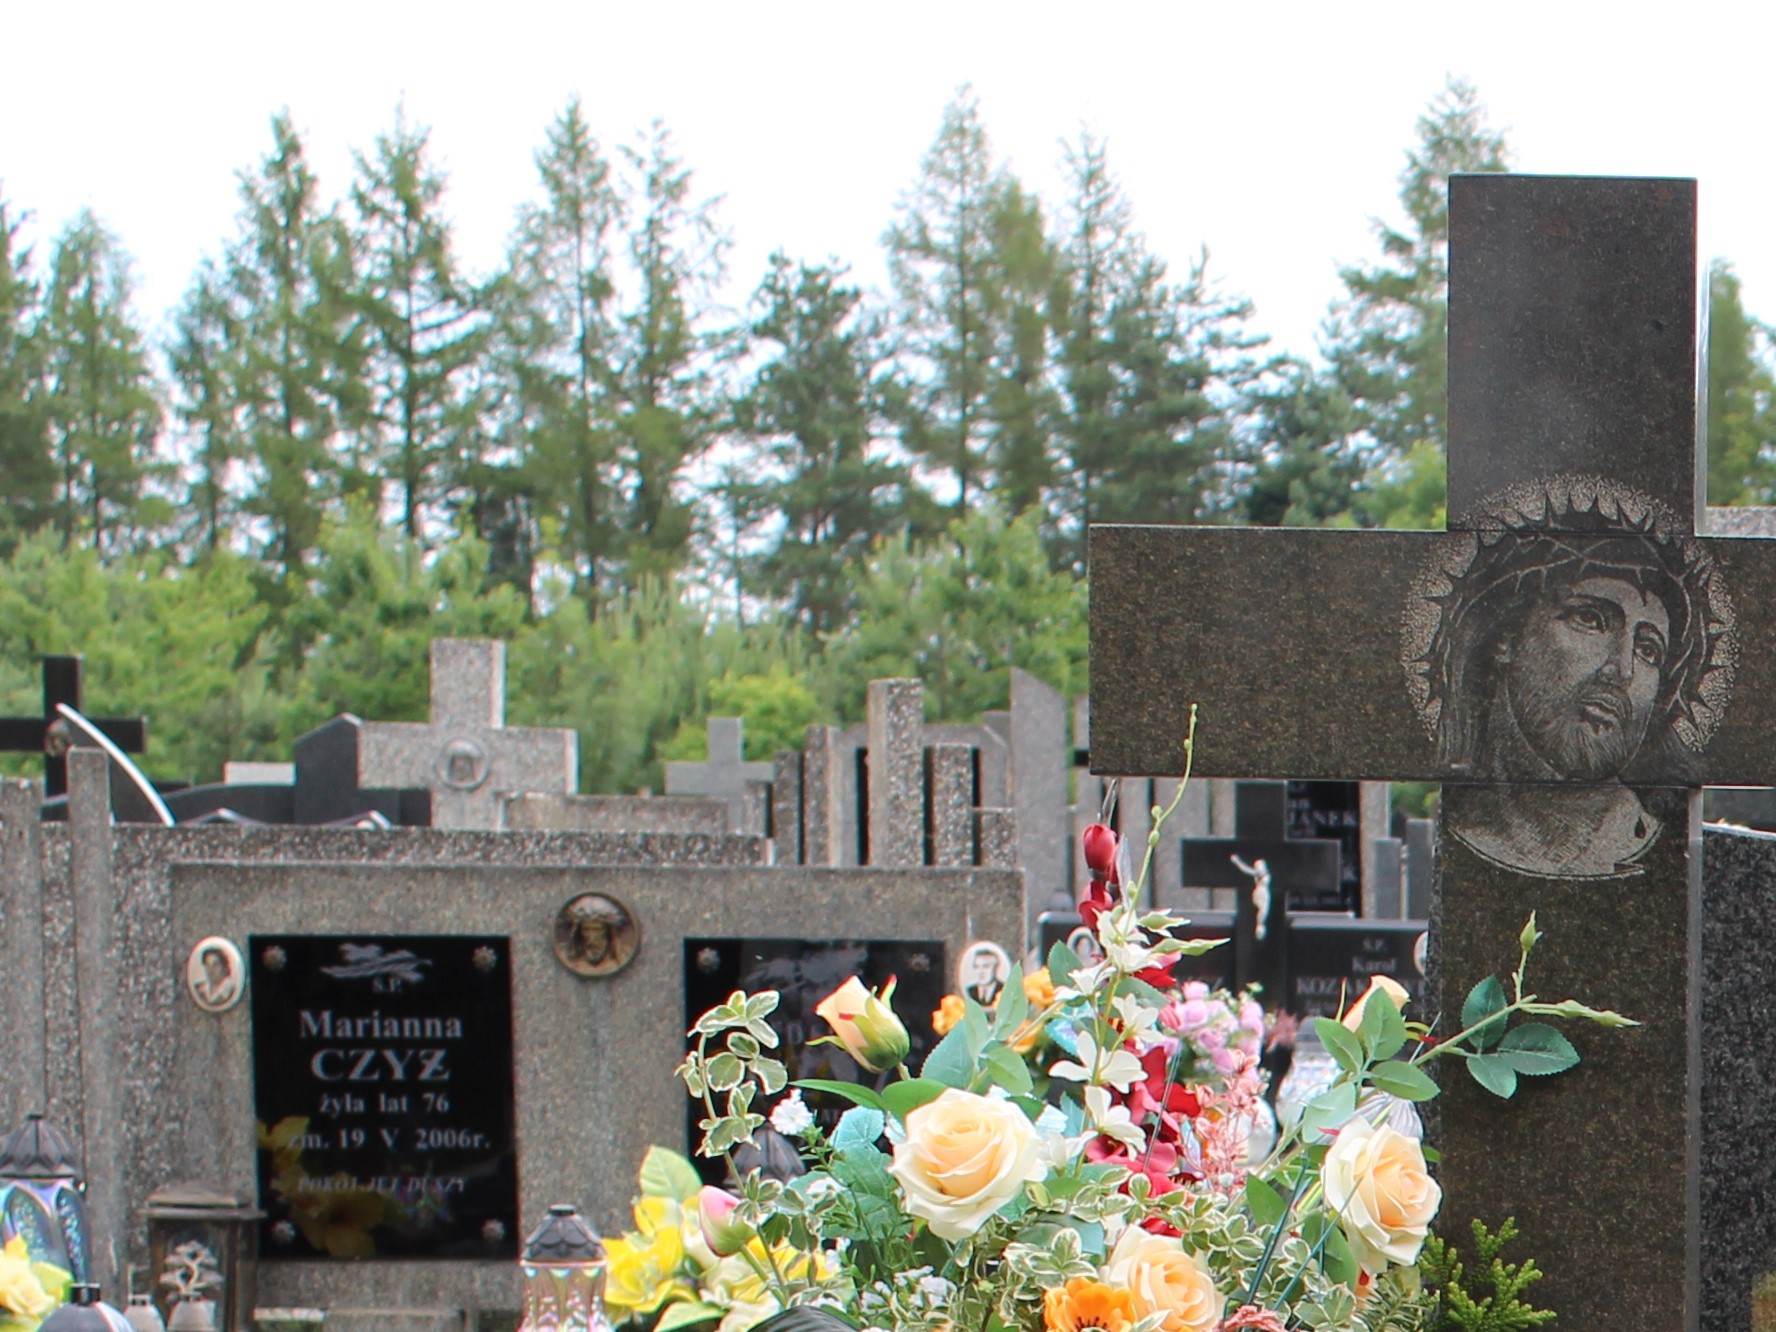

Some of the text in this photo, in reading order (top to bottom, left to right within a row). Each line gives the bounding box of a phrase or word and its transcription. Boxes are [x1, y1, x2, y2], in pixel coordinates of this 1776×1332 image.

[299, 1010, 464, 1039] Marianna
[378, 1093, 409, 1114] lat
[421, 1093, 450, 1114] 76
[339, 1128, 366, 1149] 19
[379, 1128, 400, 1150] V
[415, 1127, 491, 1150] 2006r.
